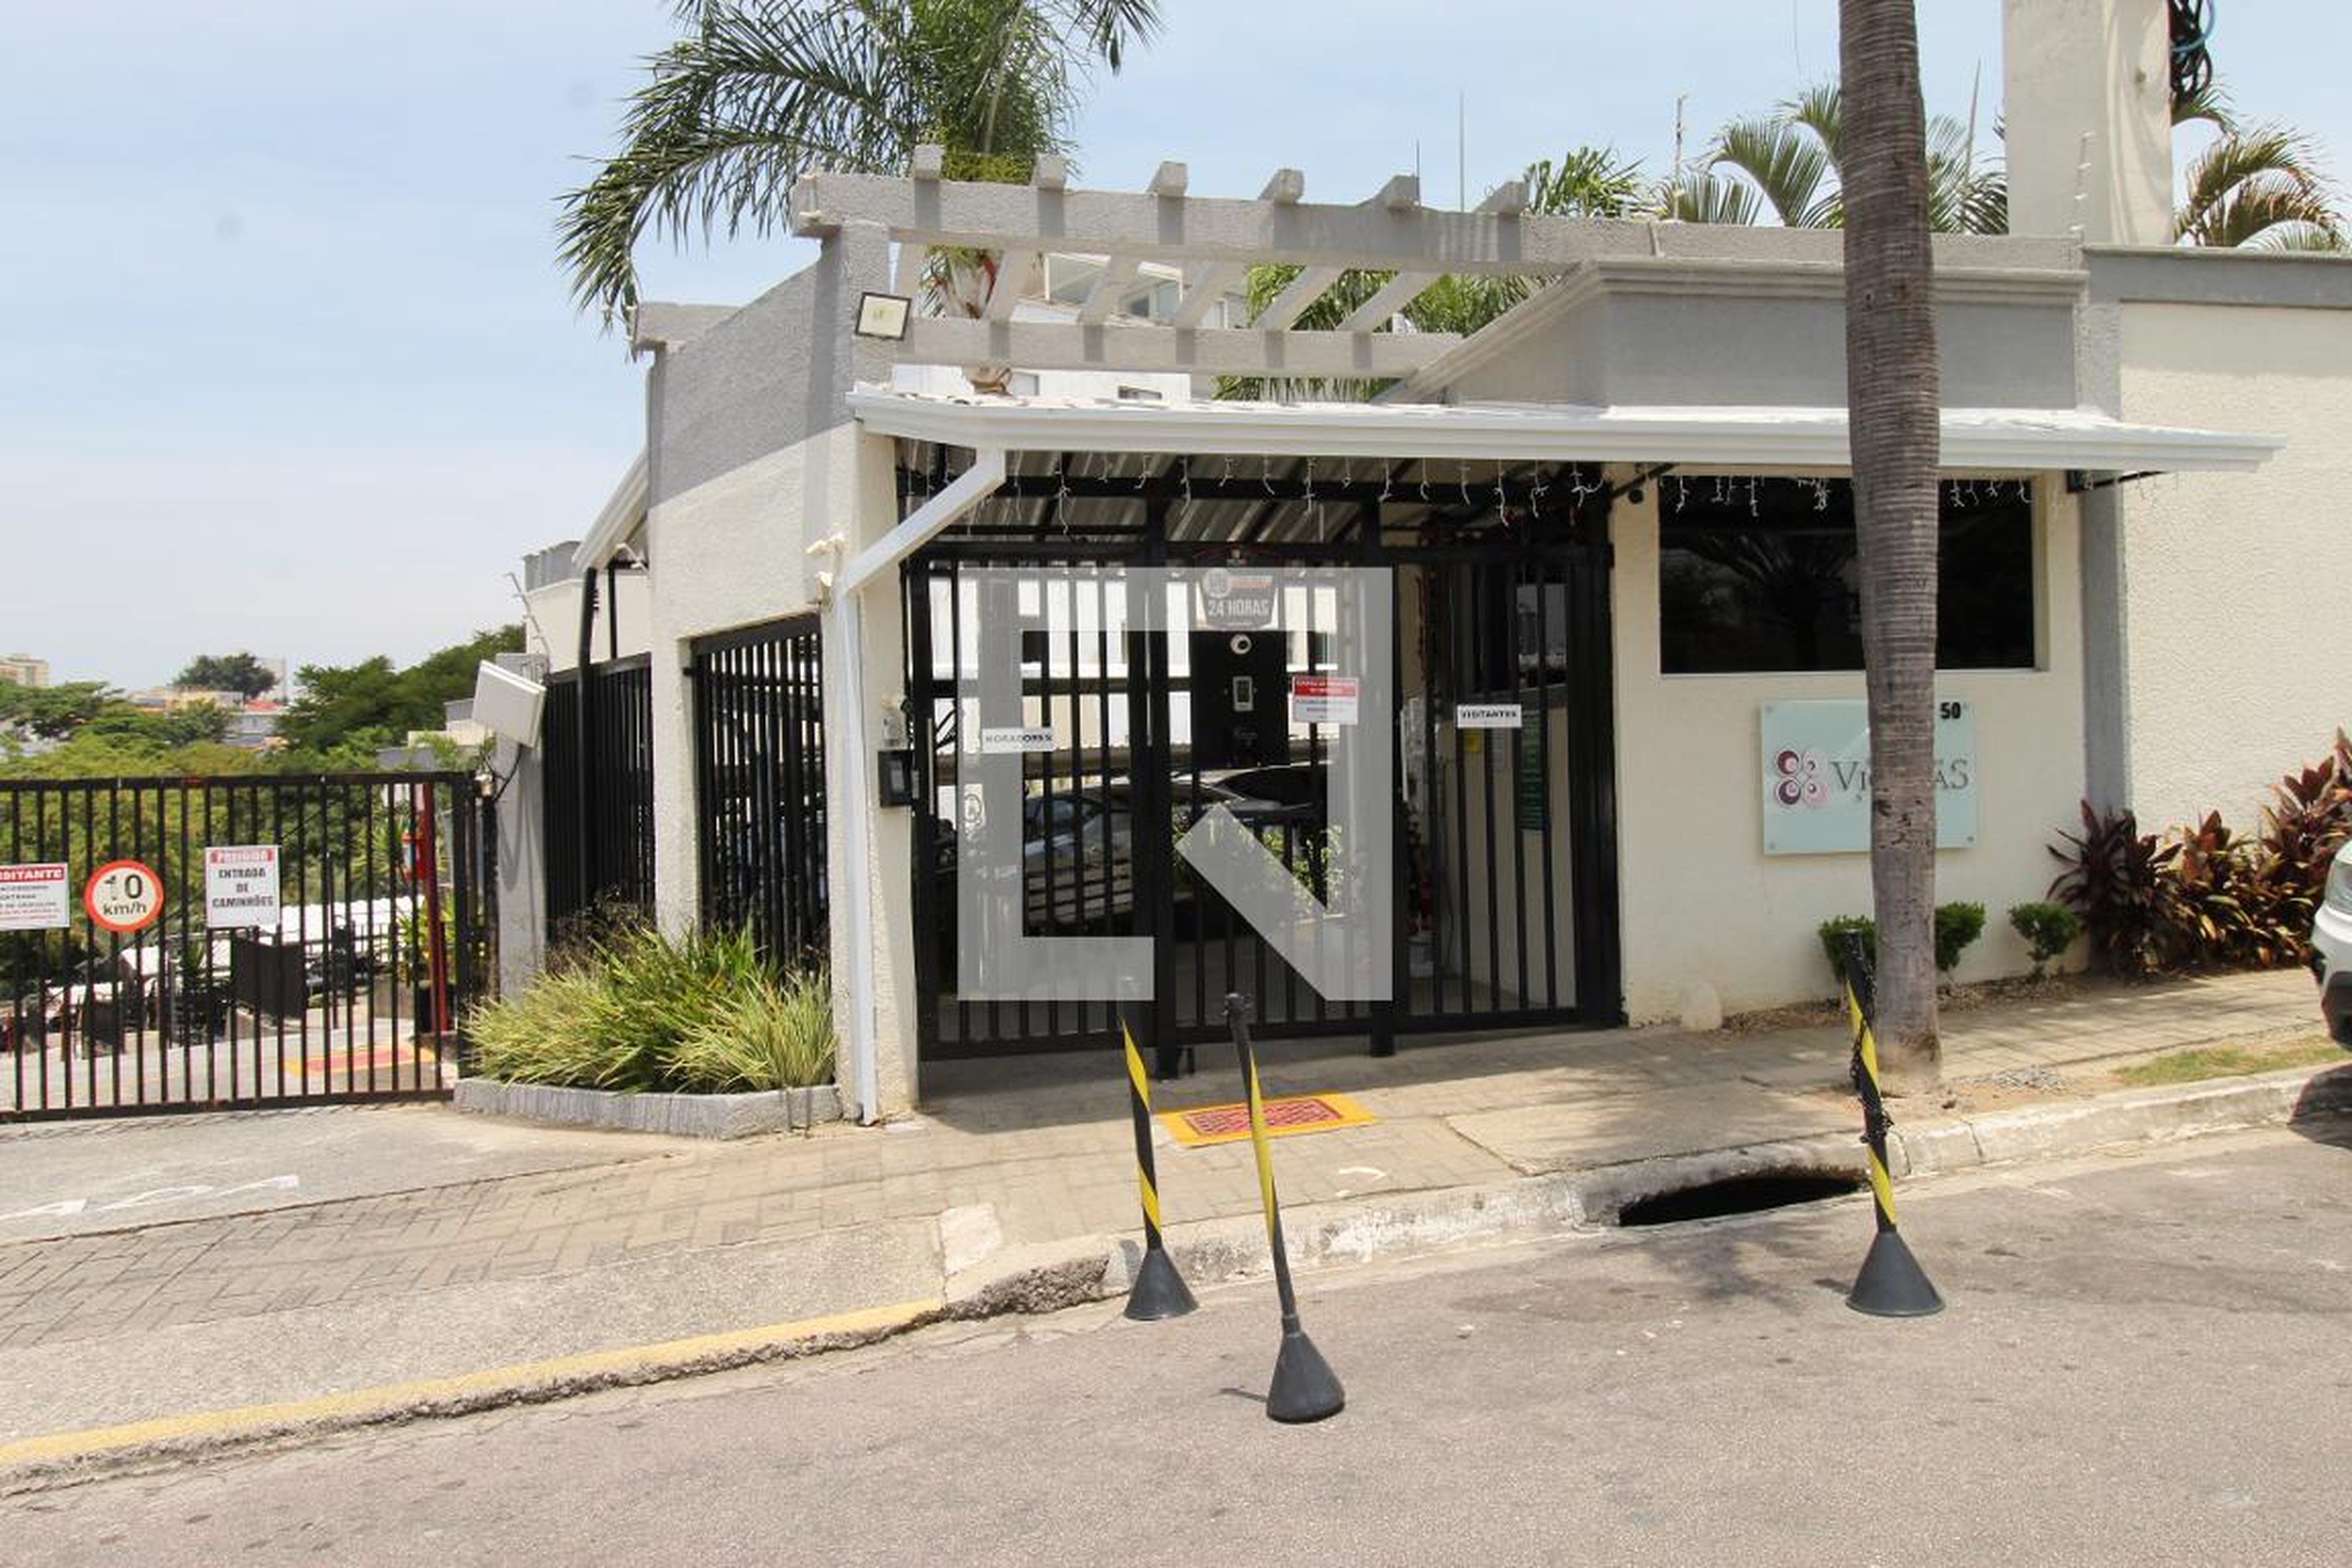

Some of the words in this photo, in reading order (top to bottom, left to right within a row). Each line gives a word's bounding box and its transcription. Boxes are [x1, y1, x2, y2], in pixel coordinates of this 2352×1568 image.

[1208, 600, 1224, 616] 24
[1227, 598, 1268, 616] HORAS
[1940, 701, 1961, 720] 50
[218, 868, 266, 878] ENTRADA
[236, 883, 249, 893] DE
[103, 903, 146, 915] km/h
